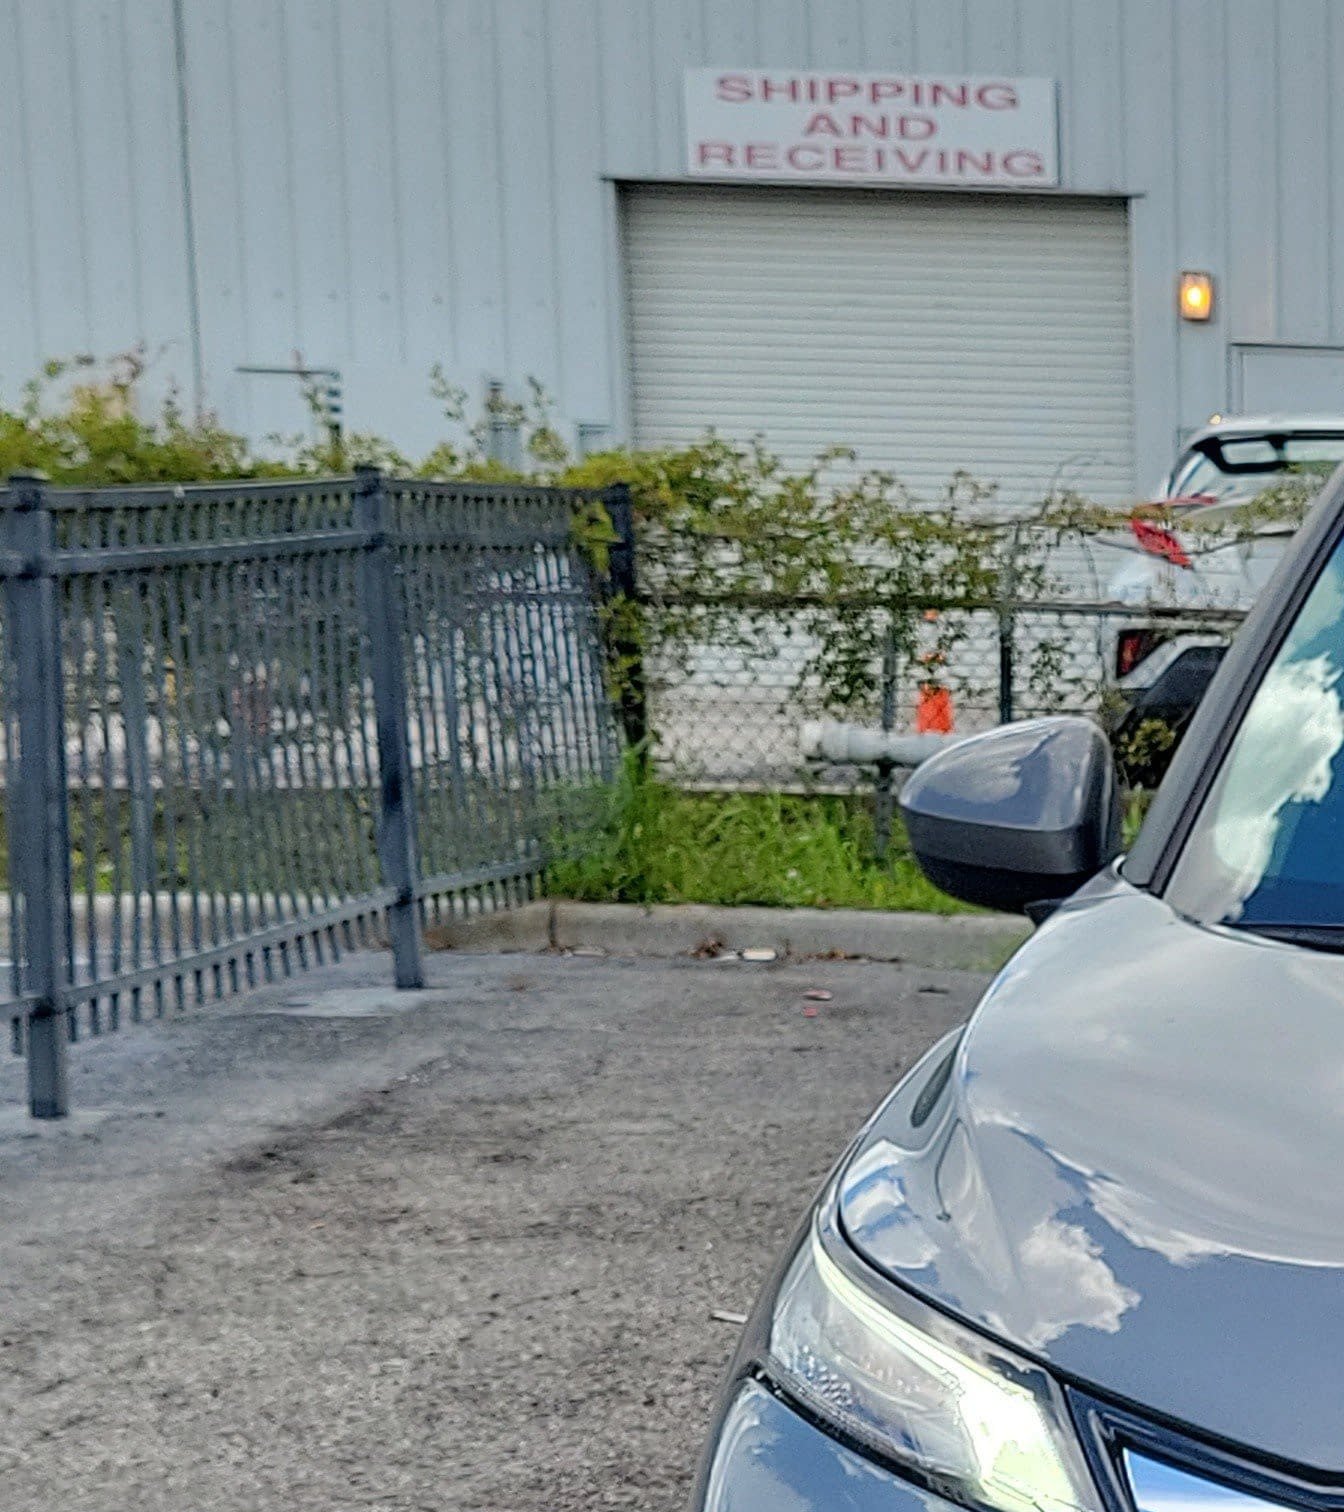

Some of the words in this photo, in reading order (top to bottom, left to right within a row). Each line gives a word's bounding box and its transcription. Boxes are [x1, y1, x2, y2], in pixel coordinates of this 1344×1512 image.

[714, 74, 1020, 110] SHIPPING
[803, 112, 938, 140] AND
[698, 142, 1045, 177] RECEIVING
